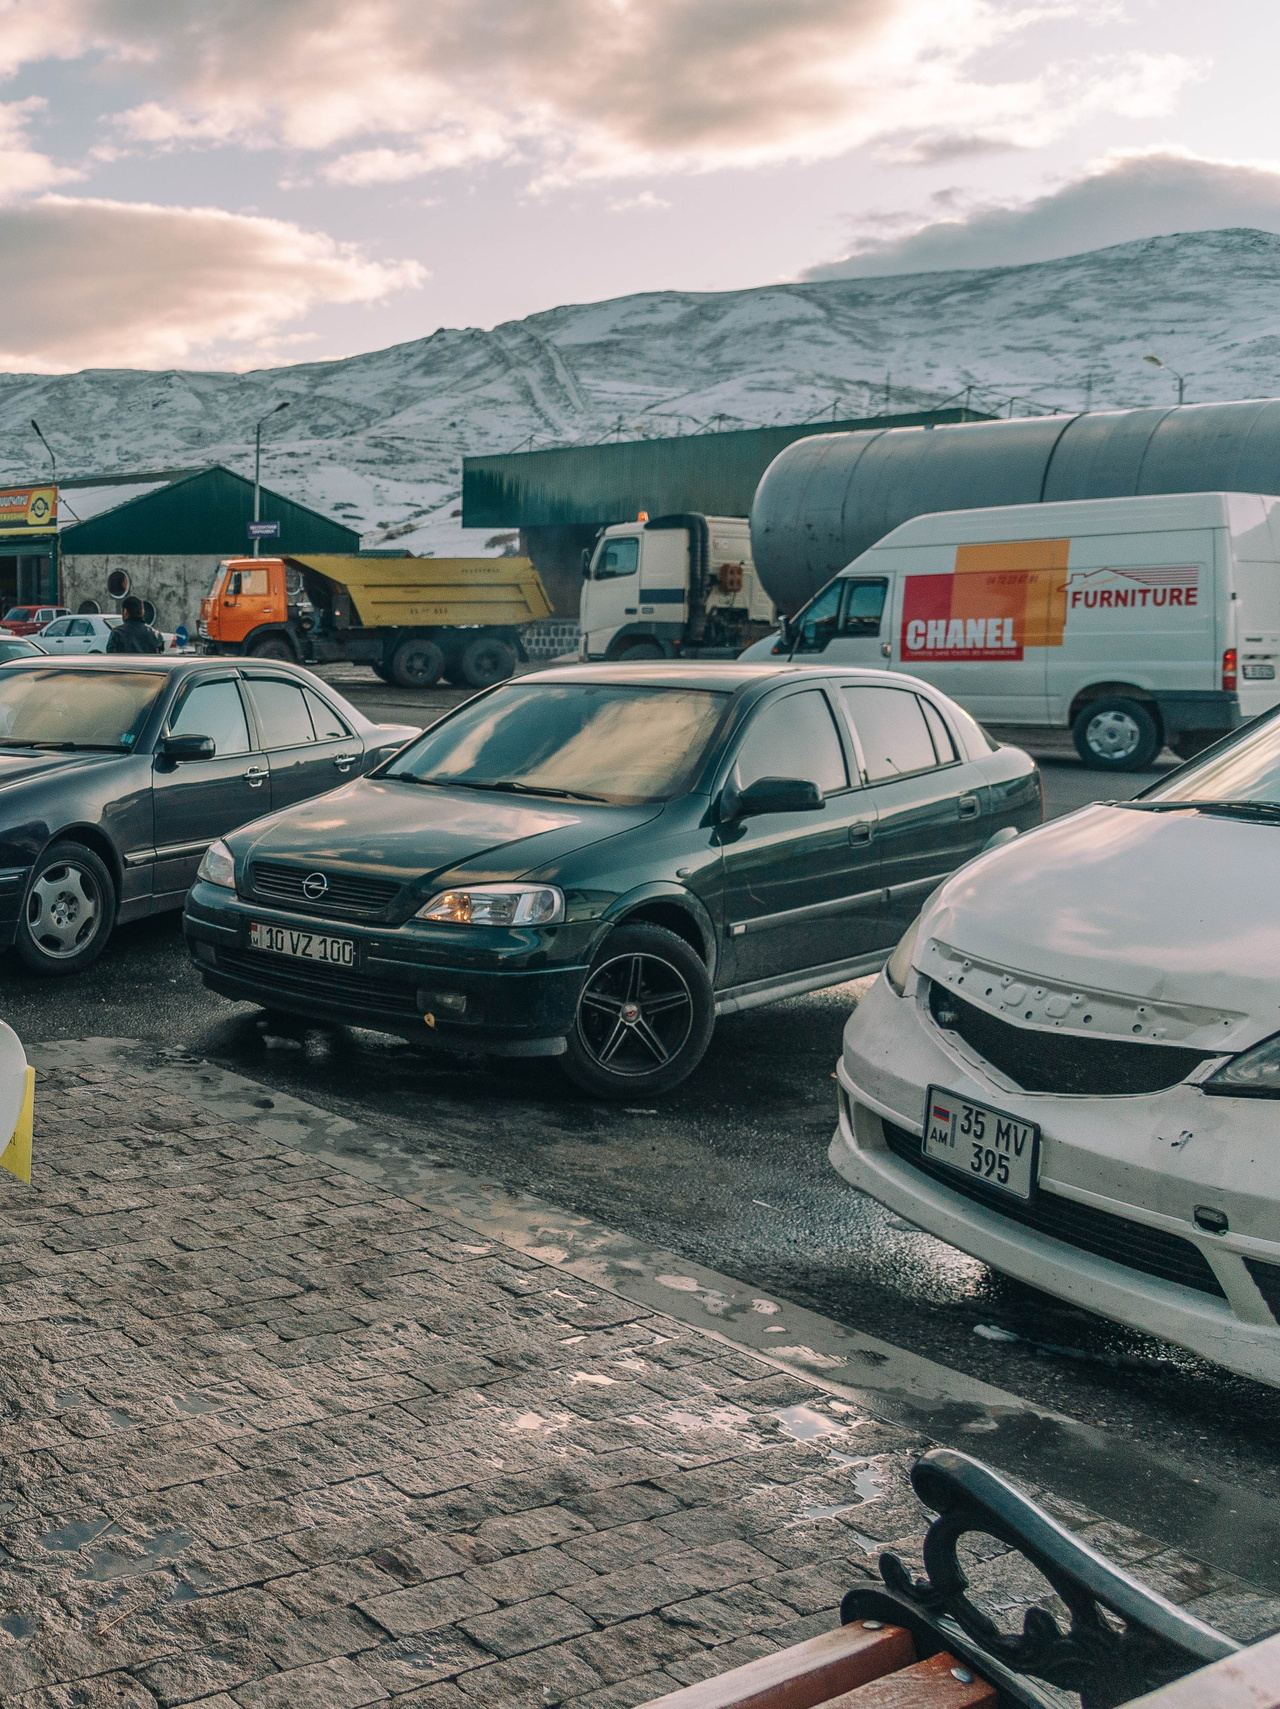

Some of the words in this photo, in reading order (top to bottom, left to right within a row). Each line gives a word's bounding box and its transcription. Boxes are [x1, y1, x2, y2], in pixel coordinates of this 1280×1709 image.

[1071, 587, 1198, 609] FURNITURE
[906, 617, 1017, 650] CHANEL
[265, 927, 284, 952] 10
[289, 931, 313, 958] VZ
[318, 937, 353, 964] 100
[929, 1126, 948, 1146] AM
[960, 1104, 986, 1140] 35
[995, 1118, 1028, 1157] MV
[970, 1141, 1010, 1184] 395
